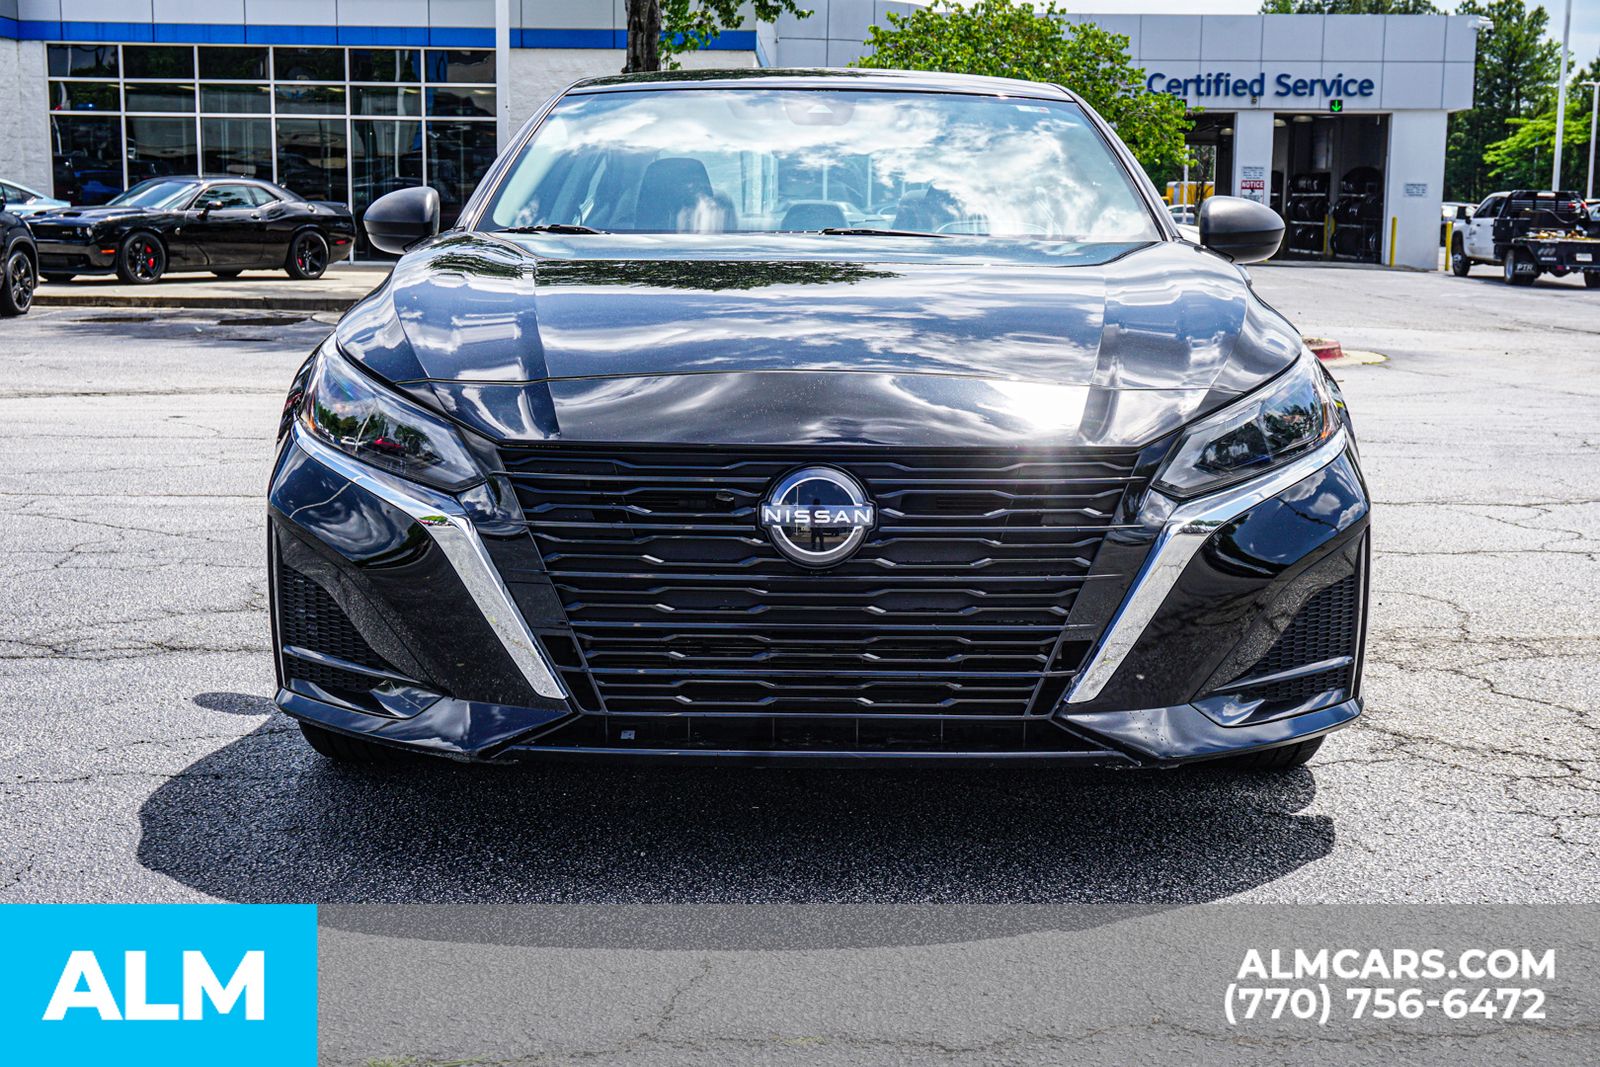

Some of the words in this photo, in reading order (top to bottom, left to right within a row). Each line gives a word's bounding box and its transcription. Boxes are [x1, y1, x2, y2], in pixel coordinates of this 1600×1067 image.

[1147, 73, 1265, 97] Certified
[1274, 74, 1374, 97] Service
[1241, 181, 1264, 189] NOTICE
[764, 509, 870, 523] NISSAN
